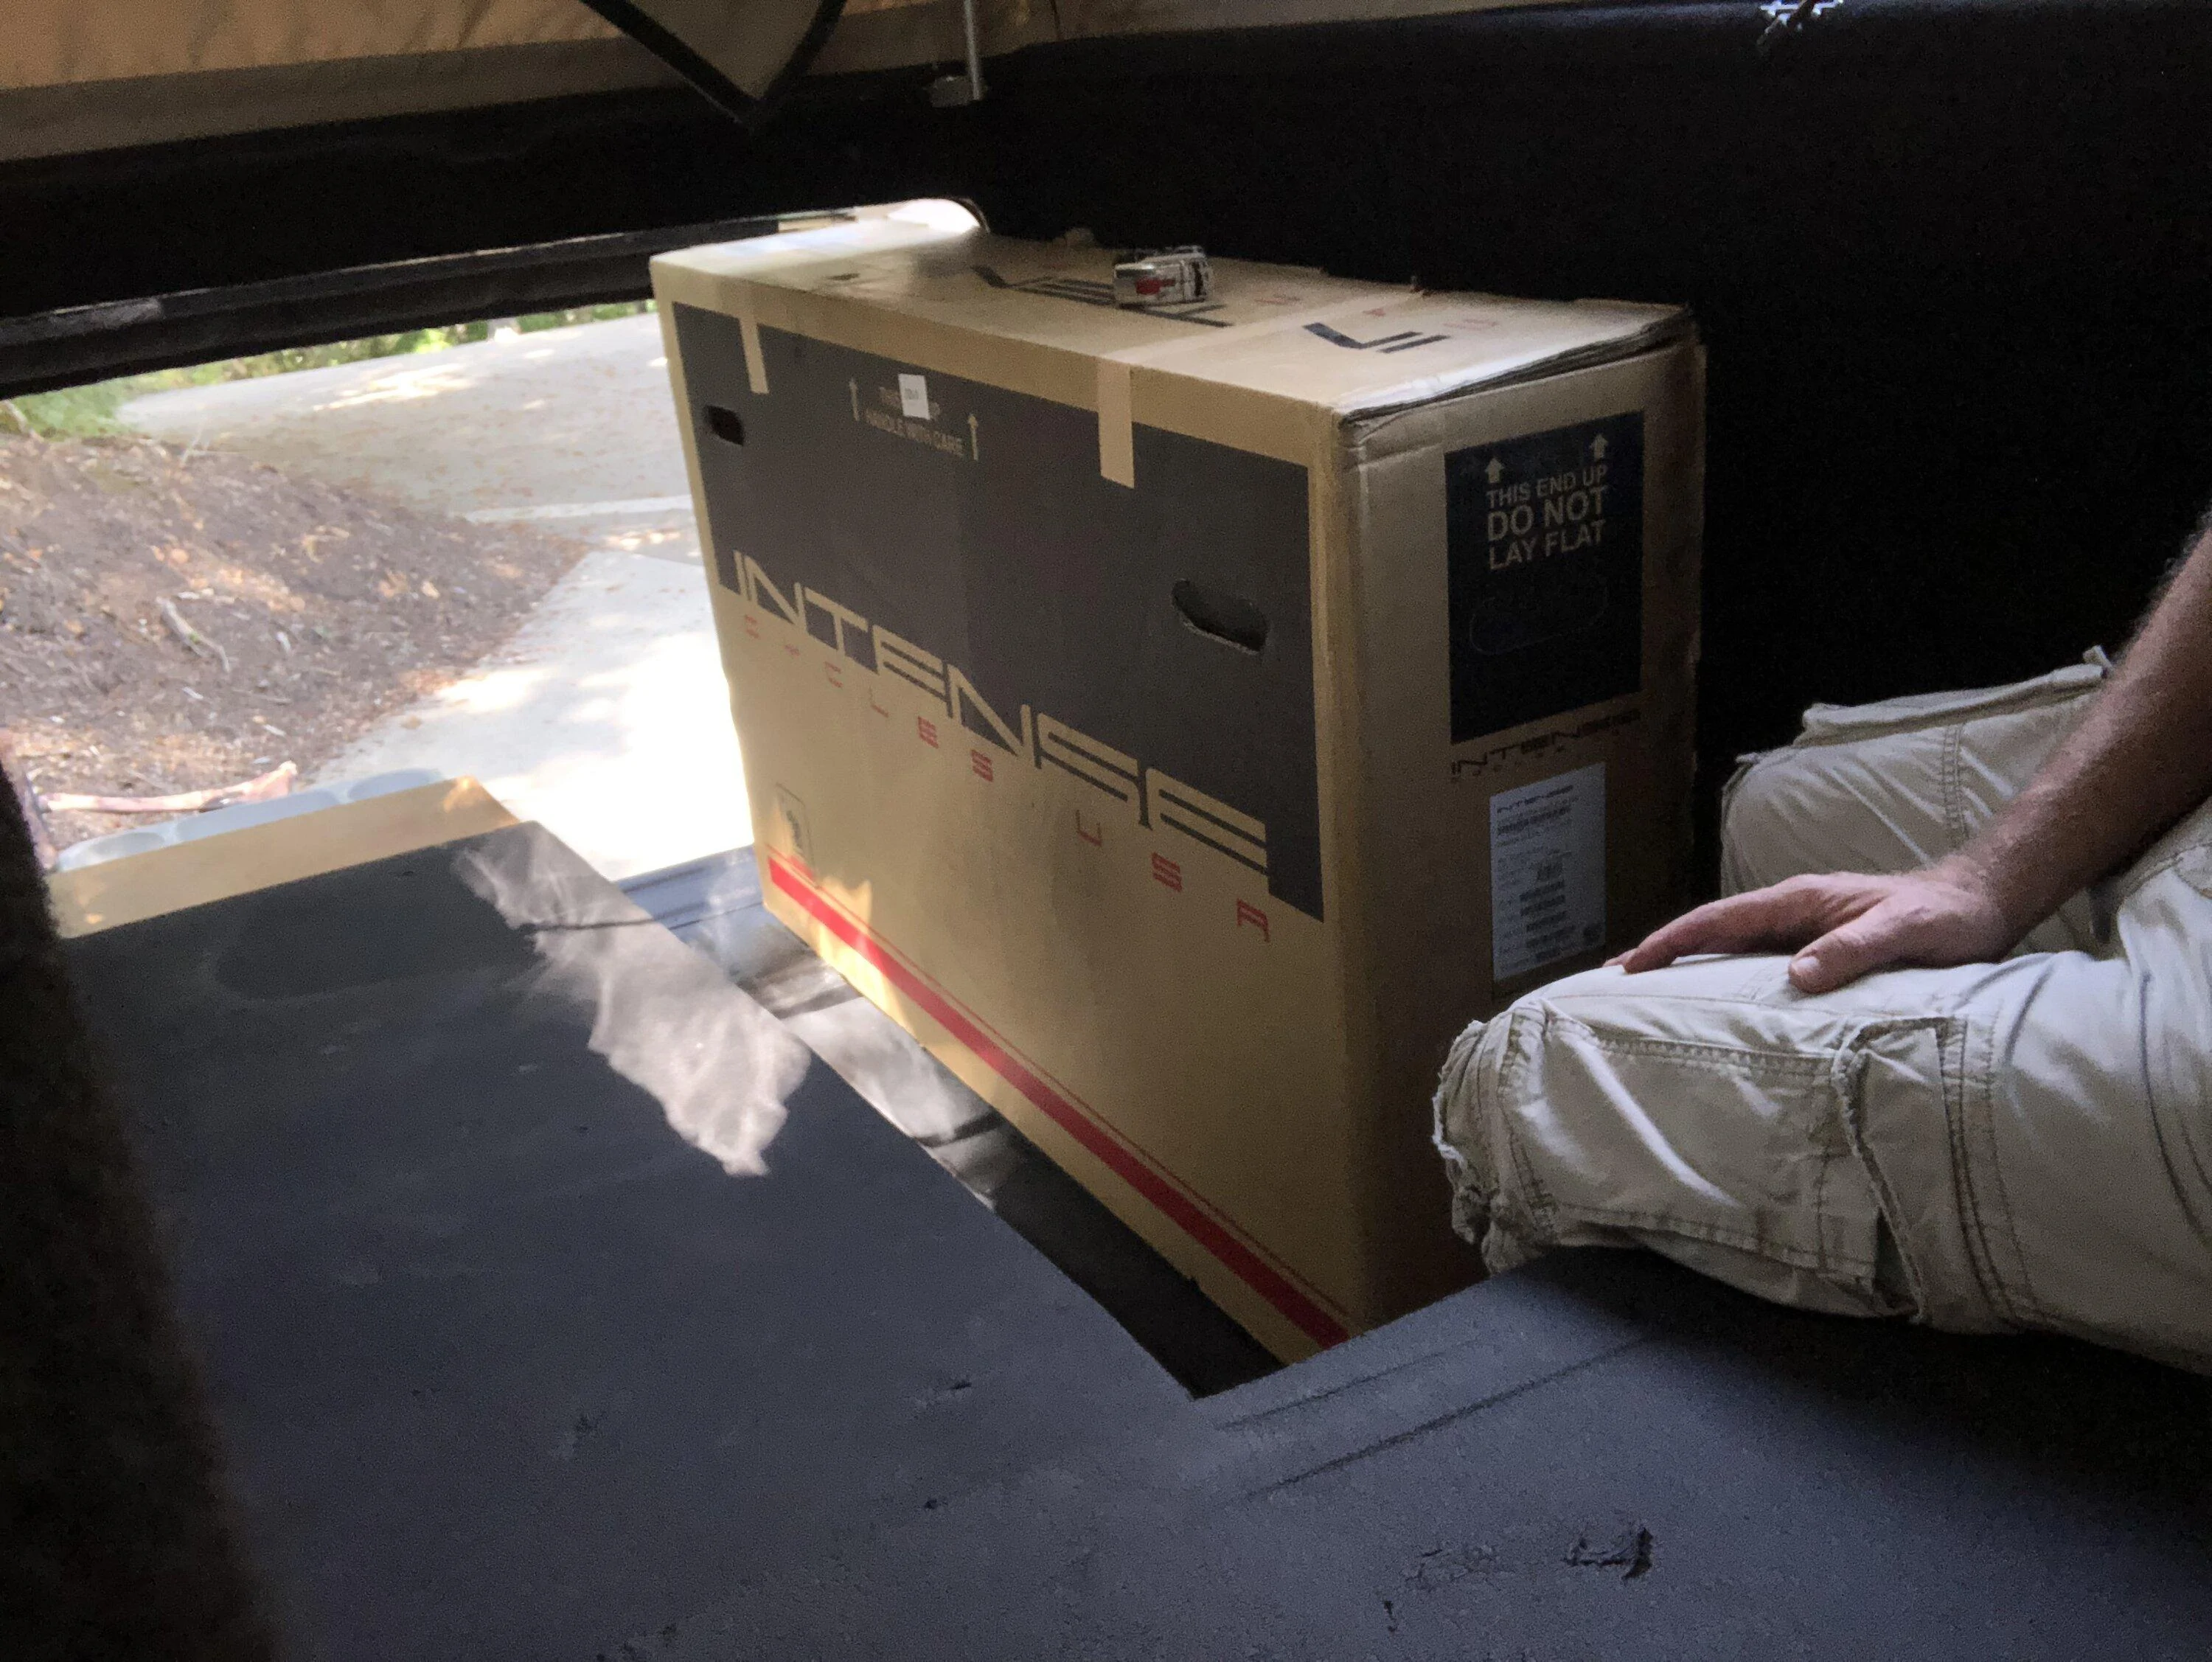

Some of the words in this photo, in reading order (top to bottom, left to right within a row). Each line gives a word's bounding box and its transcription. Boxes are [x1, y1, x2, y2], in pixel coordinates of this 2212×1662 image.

[1486, 482, 1531, 509] THIS
[1537, 472, 1576, 498] END
[1583, 464, 1609, 487] UP
[1487, 504, 1534, 542] DO
[1544, 484, 1607, 529] NOT
[1489, 537, 1537, 570] LAY
[1545, 520, 1606, 557] FLAT
[734, 549, 1271, 892] INTENSE
[1075, 809, 1270, 943] USA
